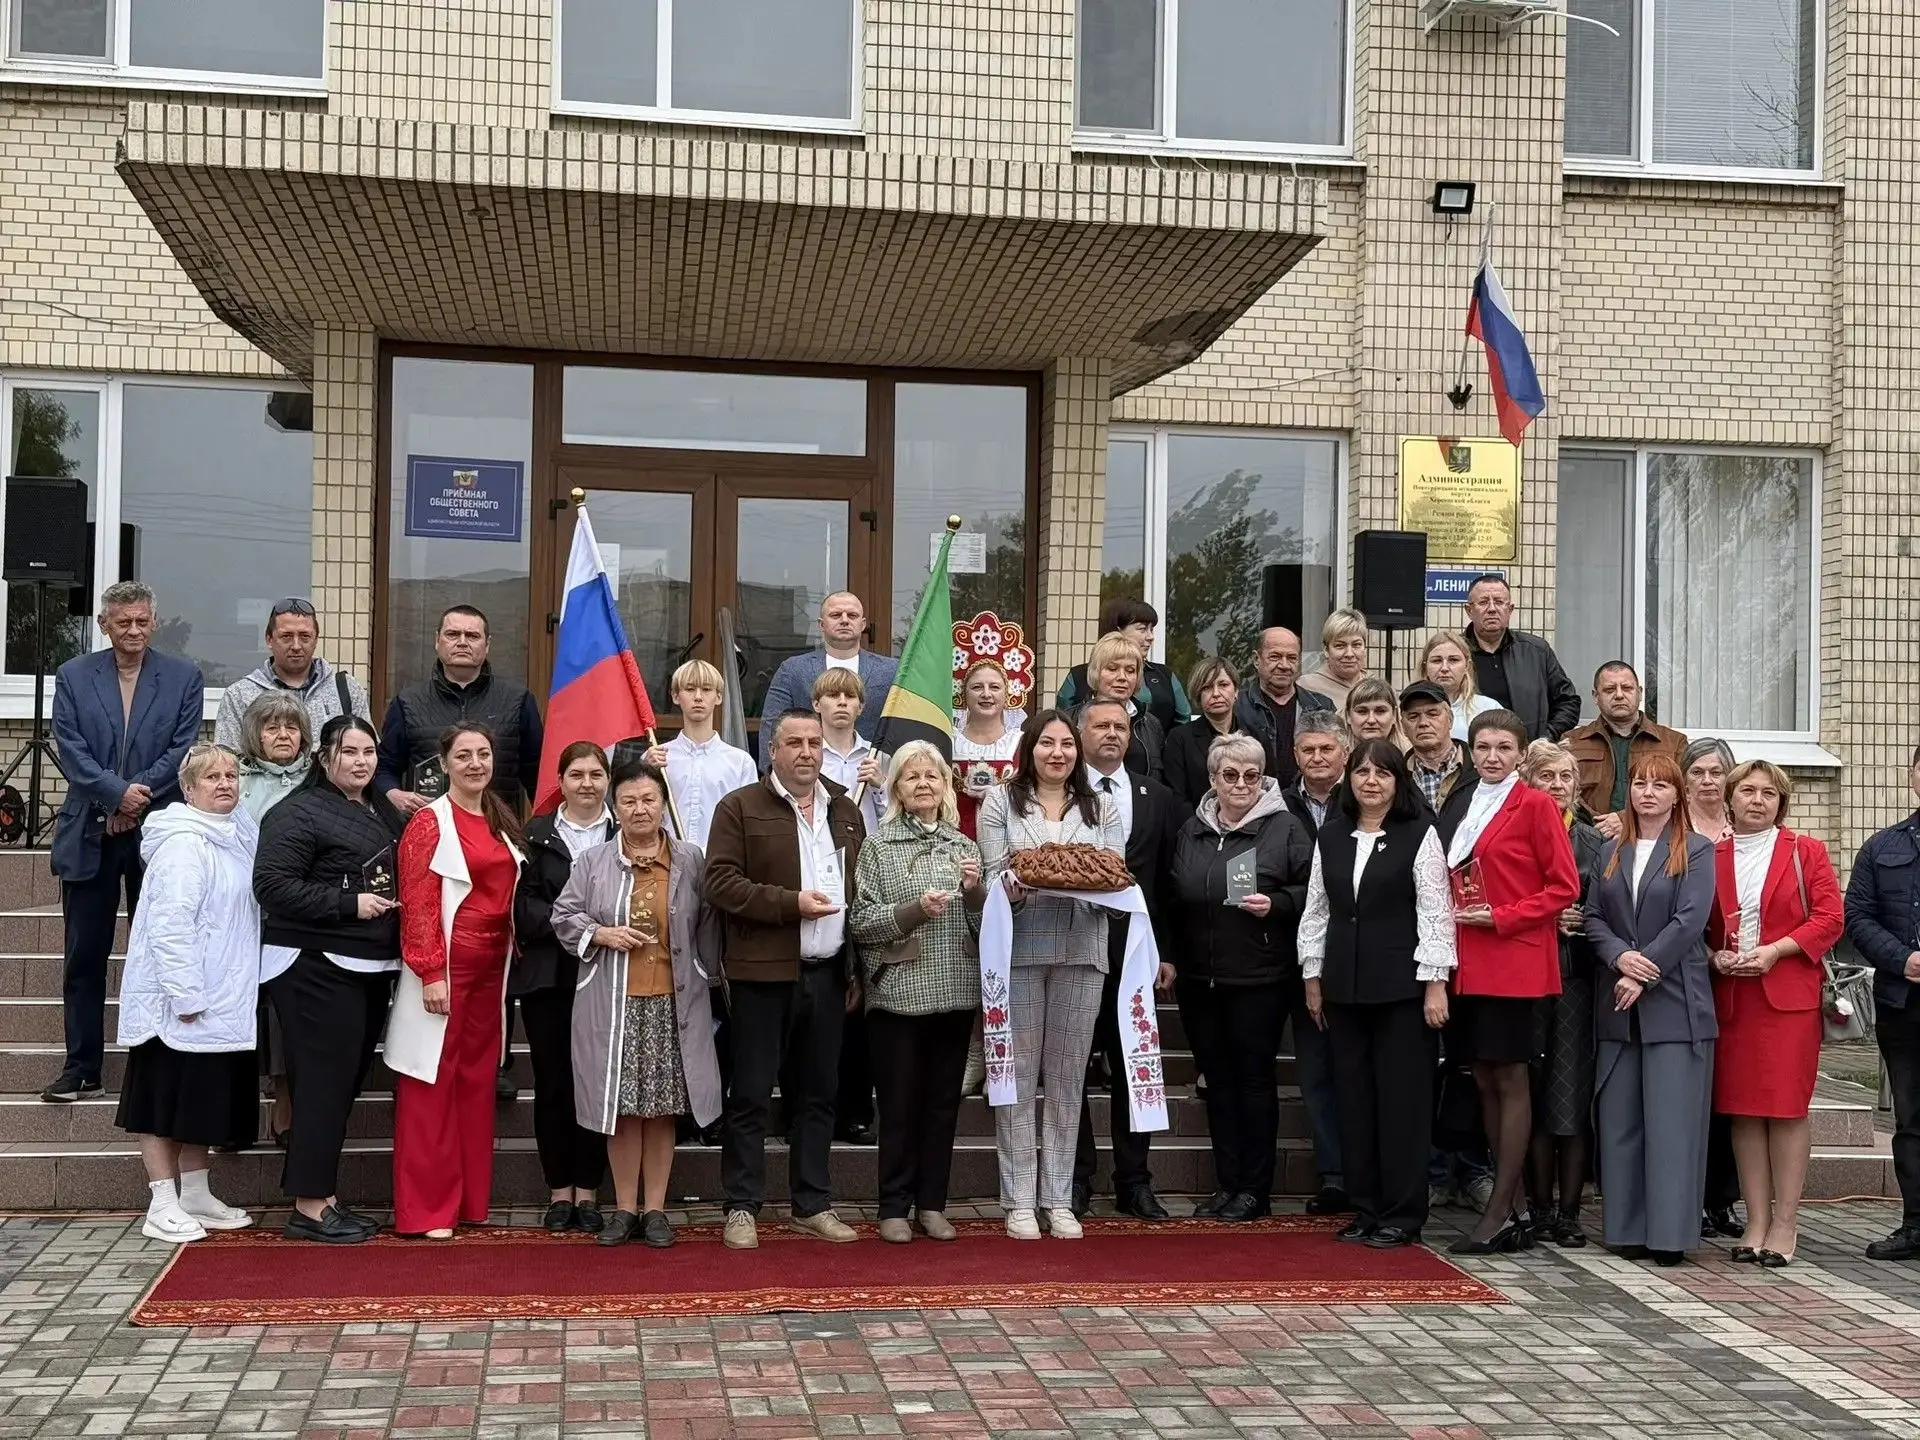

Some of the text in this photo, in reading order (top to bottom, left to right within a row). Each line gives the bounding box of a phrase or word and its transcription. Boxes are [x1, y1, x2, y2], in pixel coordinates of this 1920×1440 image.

[1418, 474, 1502, 486] Администрация
[442, 488, 487, 499] ПРИЁМНАЯ
[429, 497, 499, 510] ОБЩЕСТВЕННОГО
[448, 508, 479, 517] СОВЕТА
